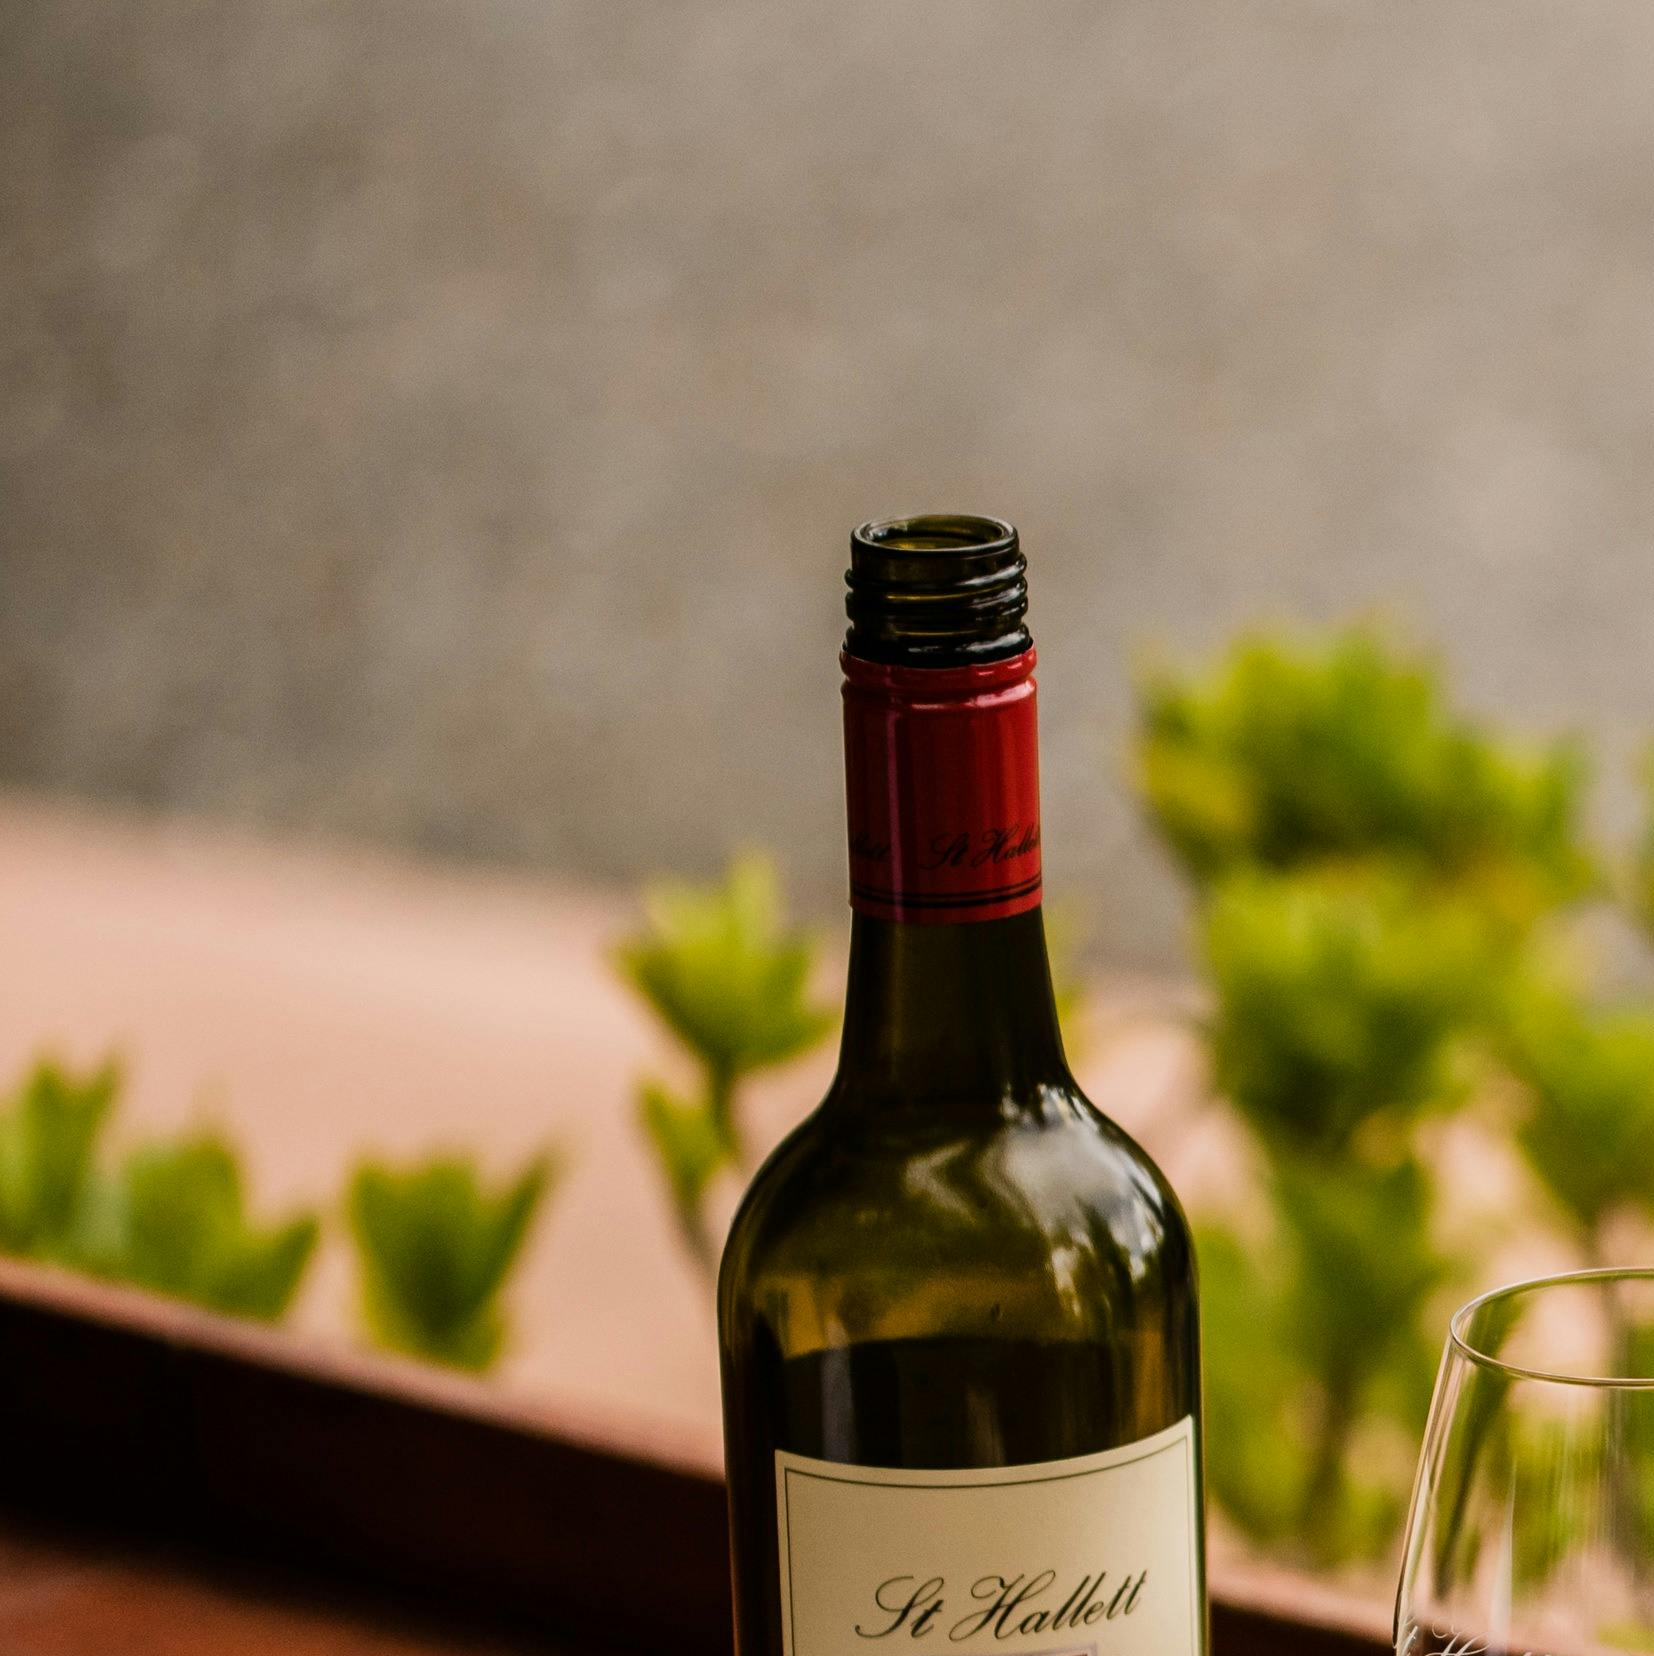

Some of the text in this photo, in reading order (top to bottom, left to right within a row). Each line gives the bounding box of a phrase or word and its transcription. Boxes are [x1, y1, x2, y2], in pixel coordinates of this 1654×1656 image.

[920, 832, 969, 871] St
[855, 1568, 1148, 1642] St Hallett
